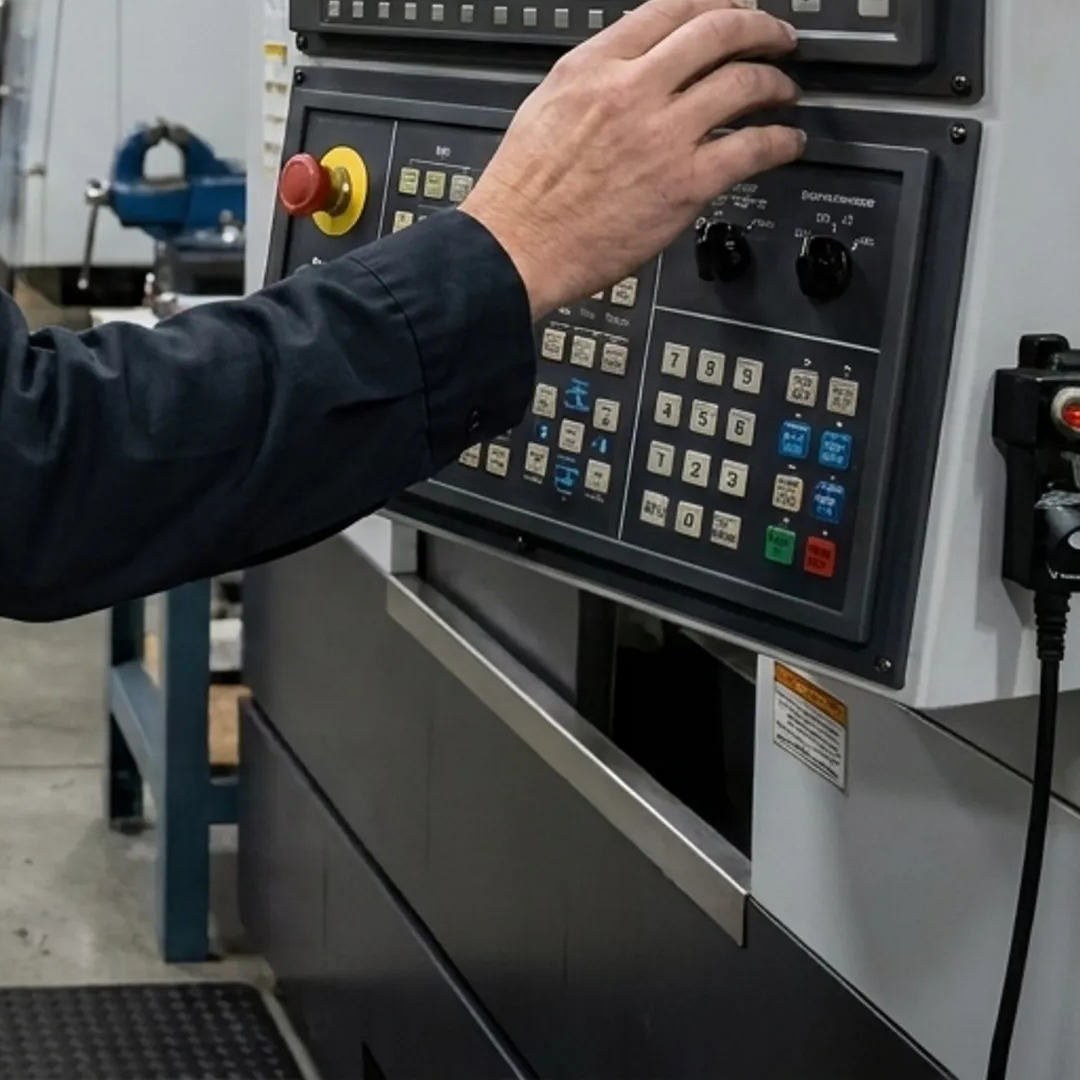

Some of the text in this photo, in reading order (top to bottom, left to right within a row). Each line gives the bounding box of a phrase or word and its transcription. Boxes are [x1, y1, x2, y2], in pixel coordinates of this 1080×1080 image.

[670, 352, 679, 368] 7
[698, 411, 708, 427] 5
[735, 420, 745, 437] 6
[690, 461, 702, 478] 2
[726, 471, 737, 488] 3
